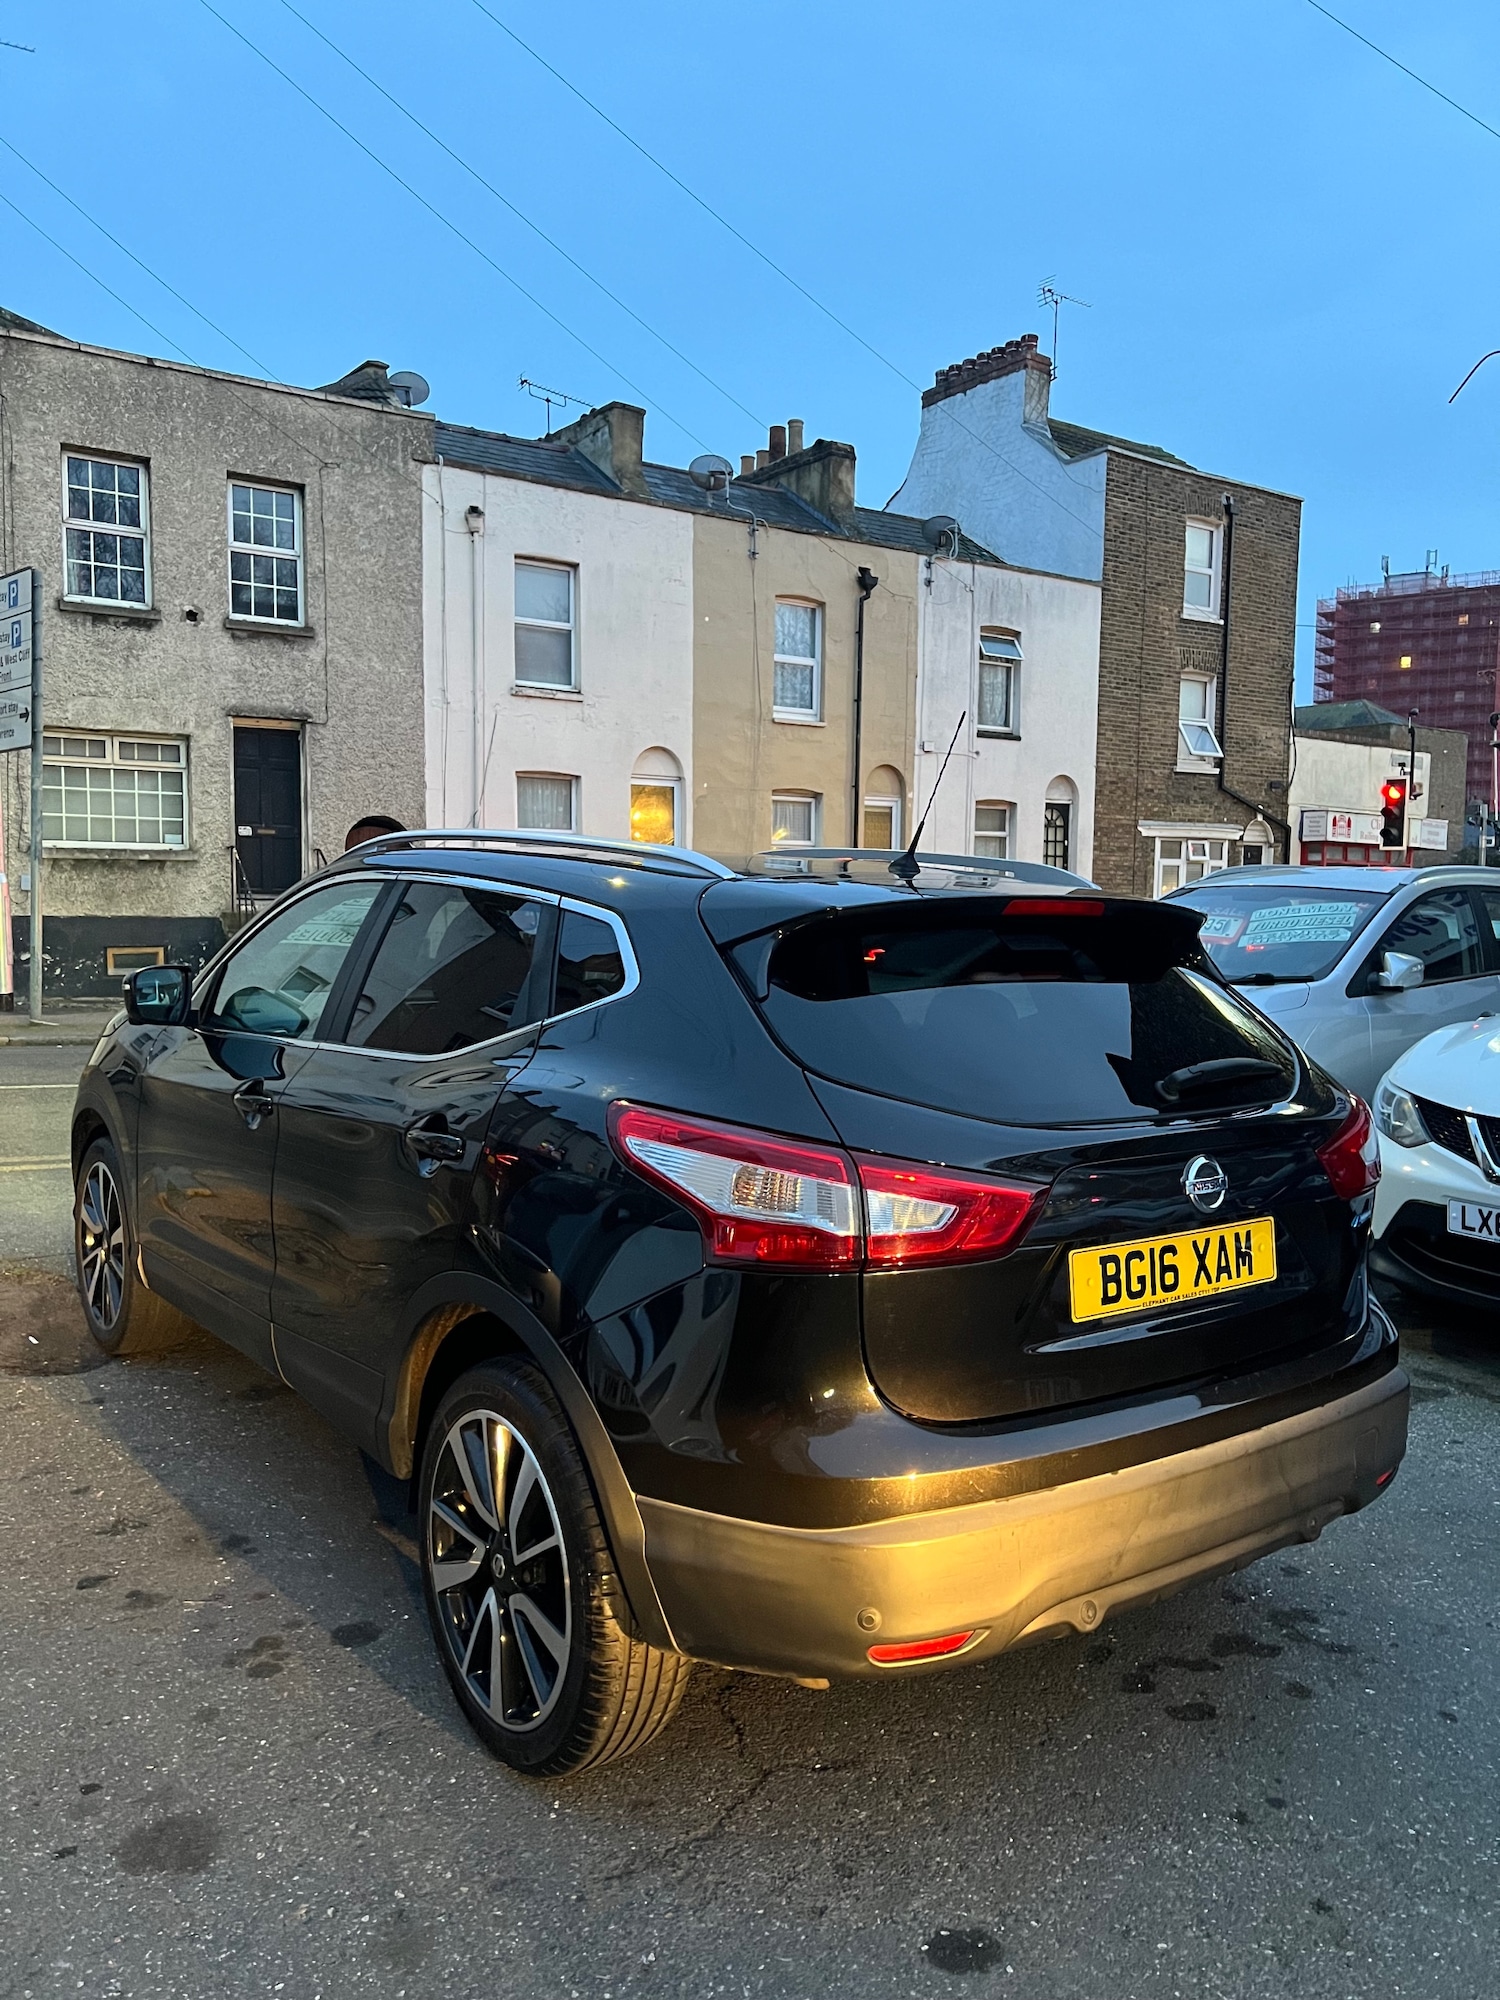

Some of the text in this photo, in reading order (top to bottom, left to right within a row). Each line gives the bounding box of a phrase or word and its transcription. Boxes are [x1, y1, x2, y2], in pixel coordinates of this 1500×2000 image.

[10, 583, 17, 606] P
[13, 623, 20, 646] P
[19, 648, 30, 661] Cliff
[1255, 907, 1300, 918] LONG
[1250, 916, 1352, 932] TURBO DIESEL
[1193, 1180, 1222, 1191] NISS
[1099, 1230, 1254, 1306] BG16 XAM
[1142, 1297, 1169, 1307] ELEPHANT
[1171, 1294, 1180, 1302] CAR
[1182, 1291, 1197, 1300] SALES
